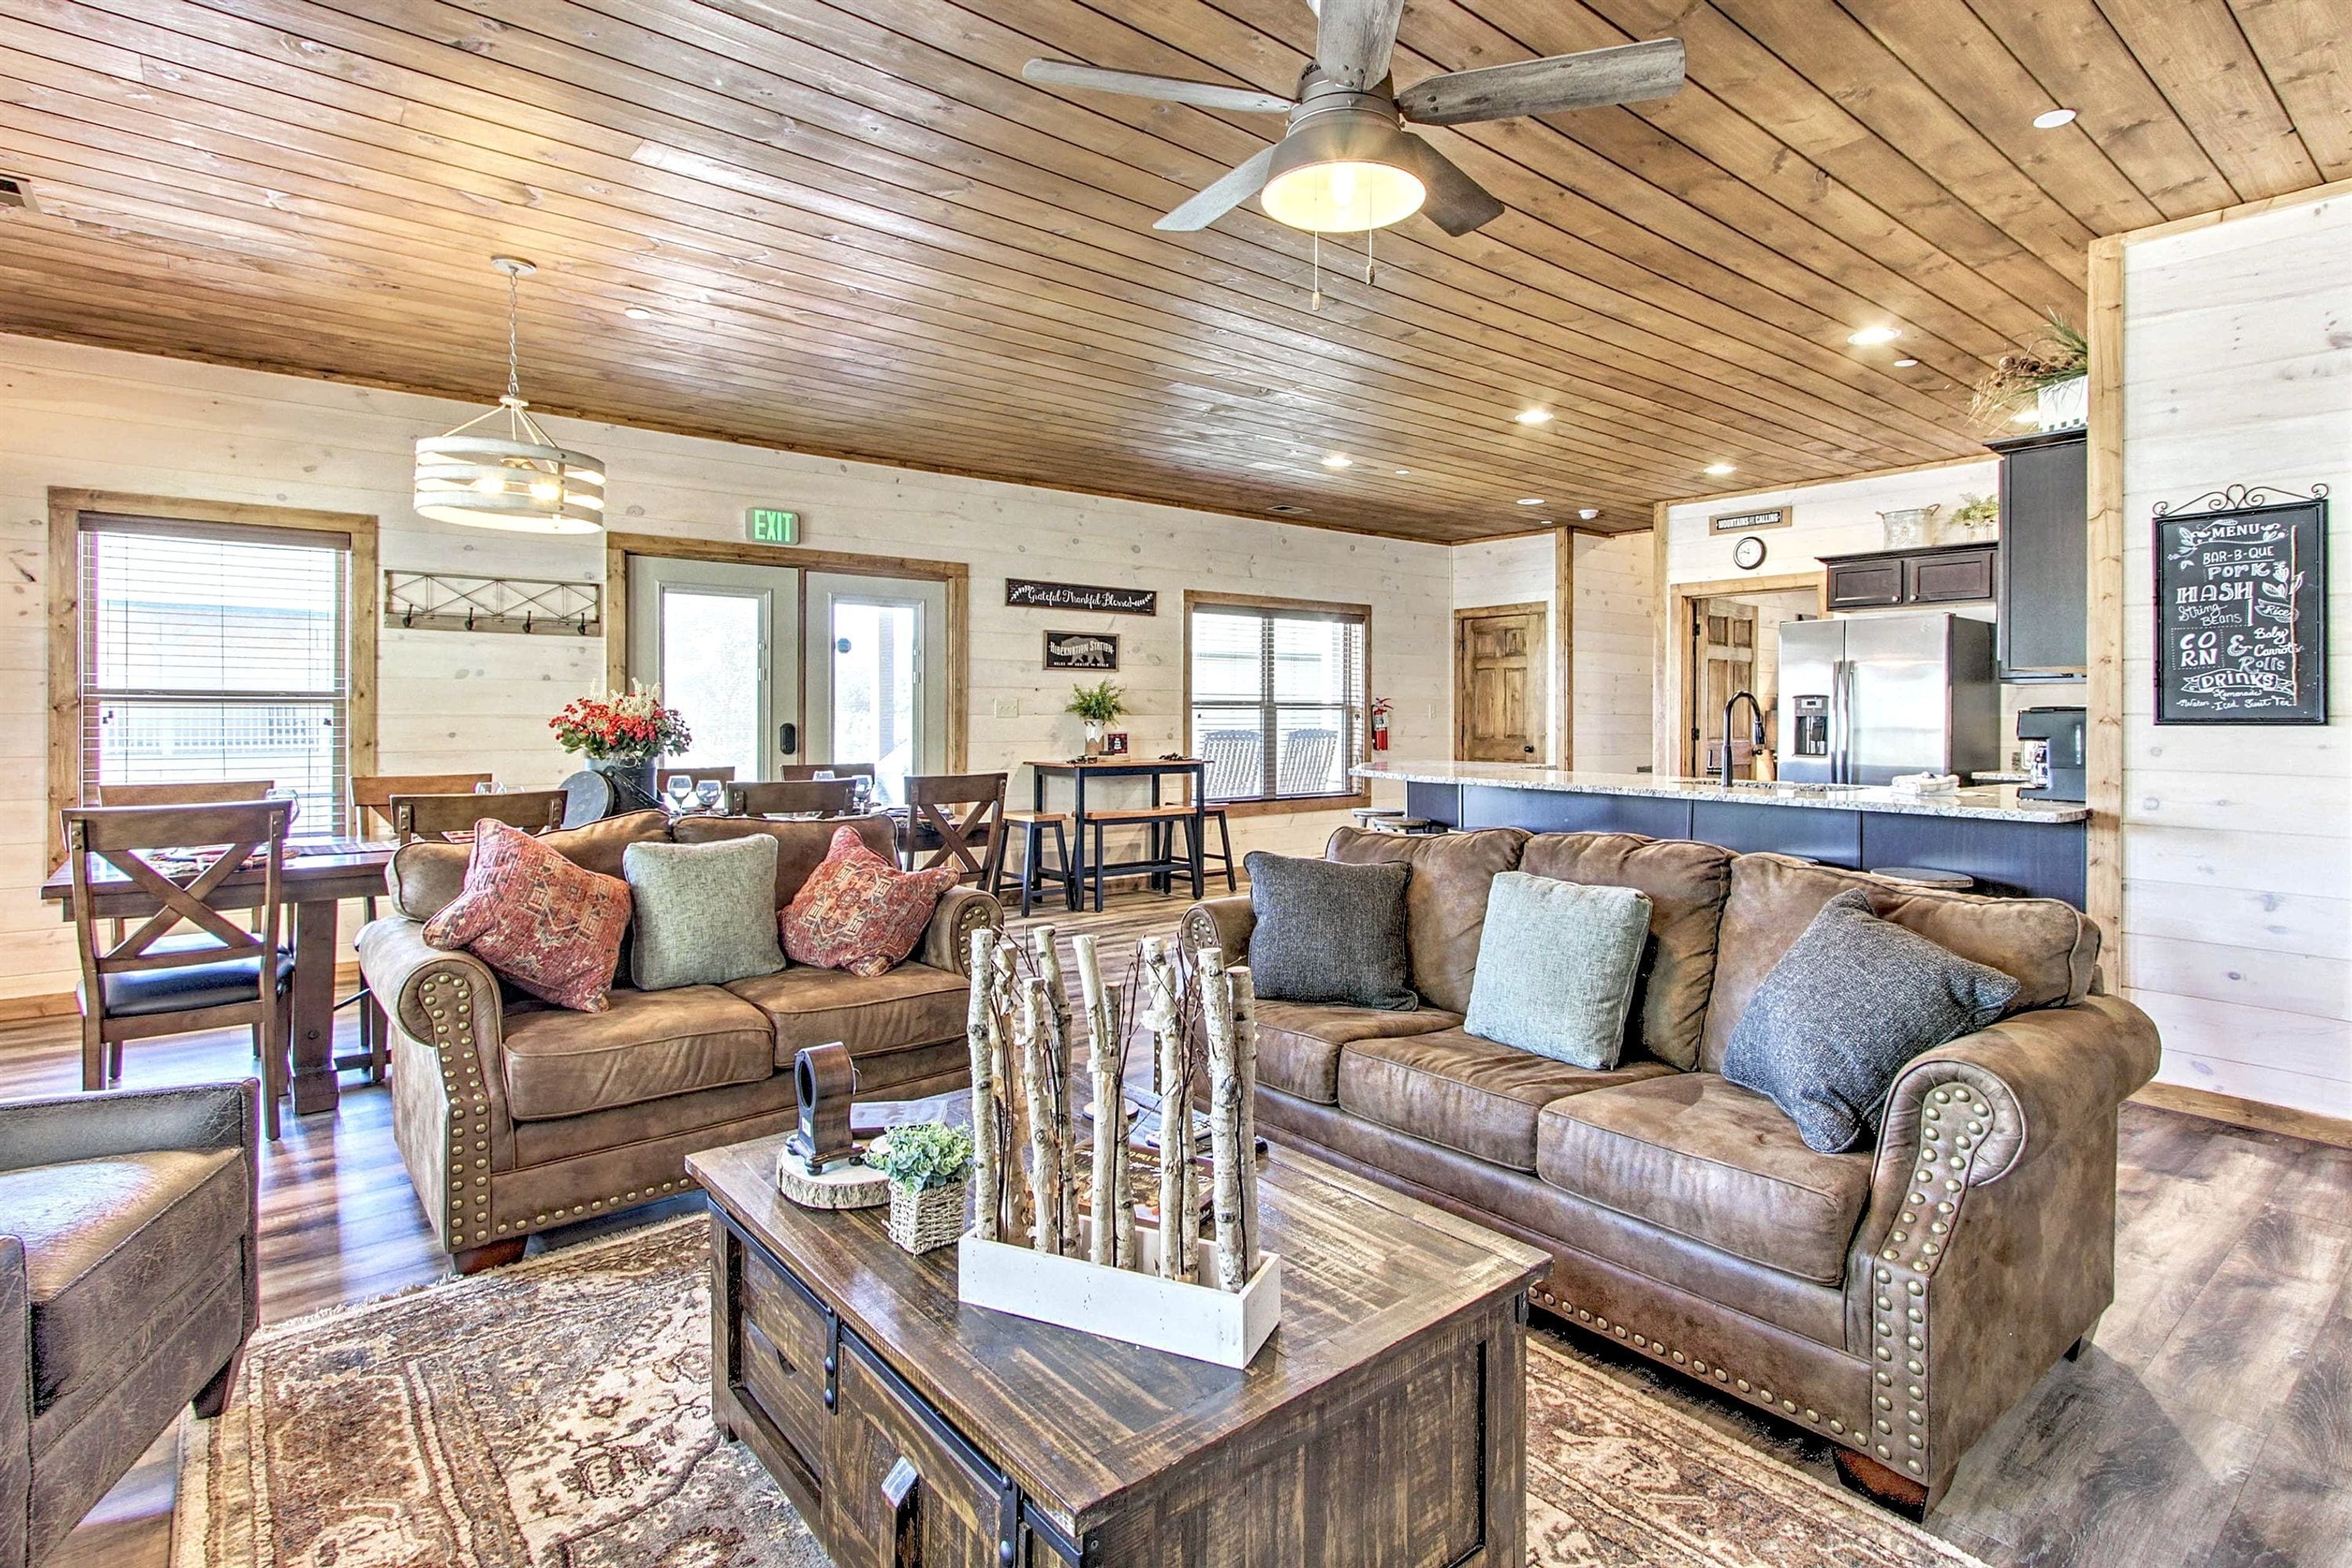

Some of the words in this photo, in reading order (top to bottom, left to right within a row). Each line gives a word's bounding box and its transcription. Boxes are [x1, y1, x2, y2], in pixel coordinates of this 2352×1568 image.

[754, 510, 793, 542] EXIT
[1719, 517, 1749, 528] MOUNTAINS
[1756, 514, 1778, 524] CALLING
[2212, 523, 2261, 538] MENU
[2202, 546, 2274, 565] BAR-B-QUE
[1028, 588, 1062, 606] Grateful
[1062, 589, 1102, 609] Thankful
[1102, 591, 1133, 608] Blessed
[2176, 581, 2254, 604] HASH
[2178, 603, 2227, 622] String
[2263, 605, 2290, 616] Rice
[2253, 626, 2288, 645] Baby
[2253, 642, 2301, 657] Carrots
[2238, 655, 2286, 675] Rolls
[2212, 687, 2263, 700] Lemonade
[2271, 695, 2293, 706] Tea
